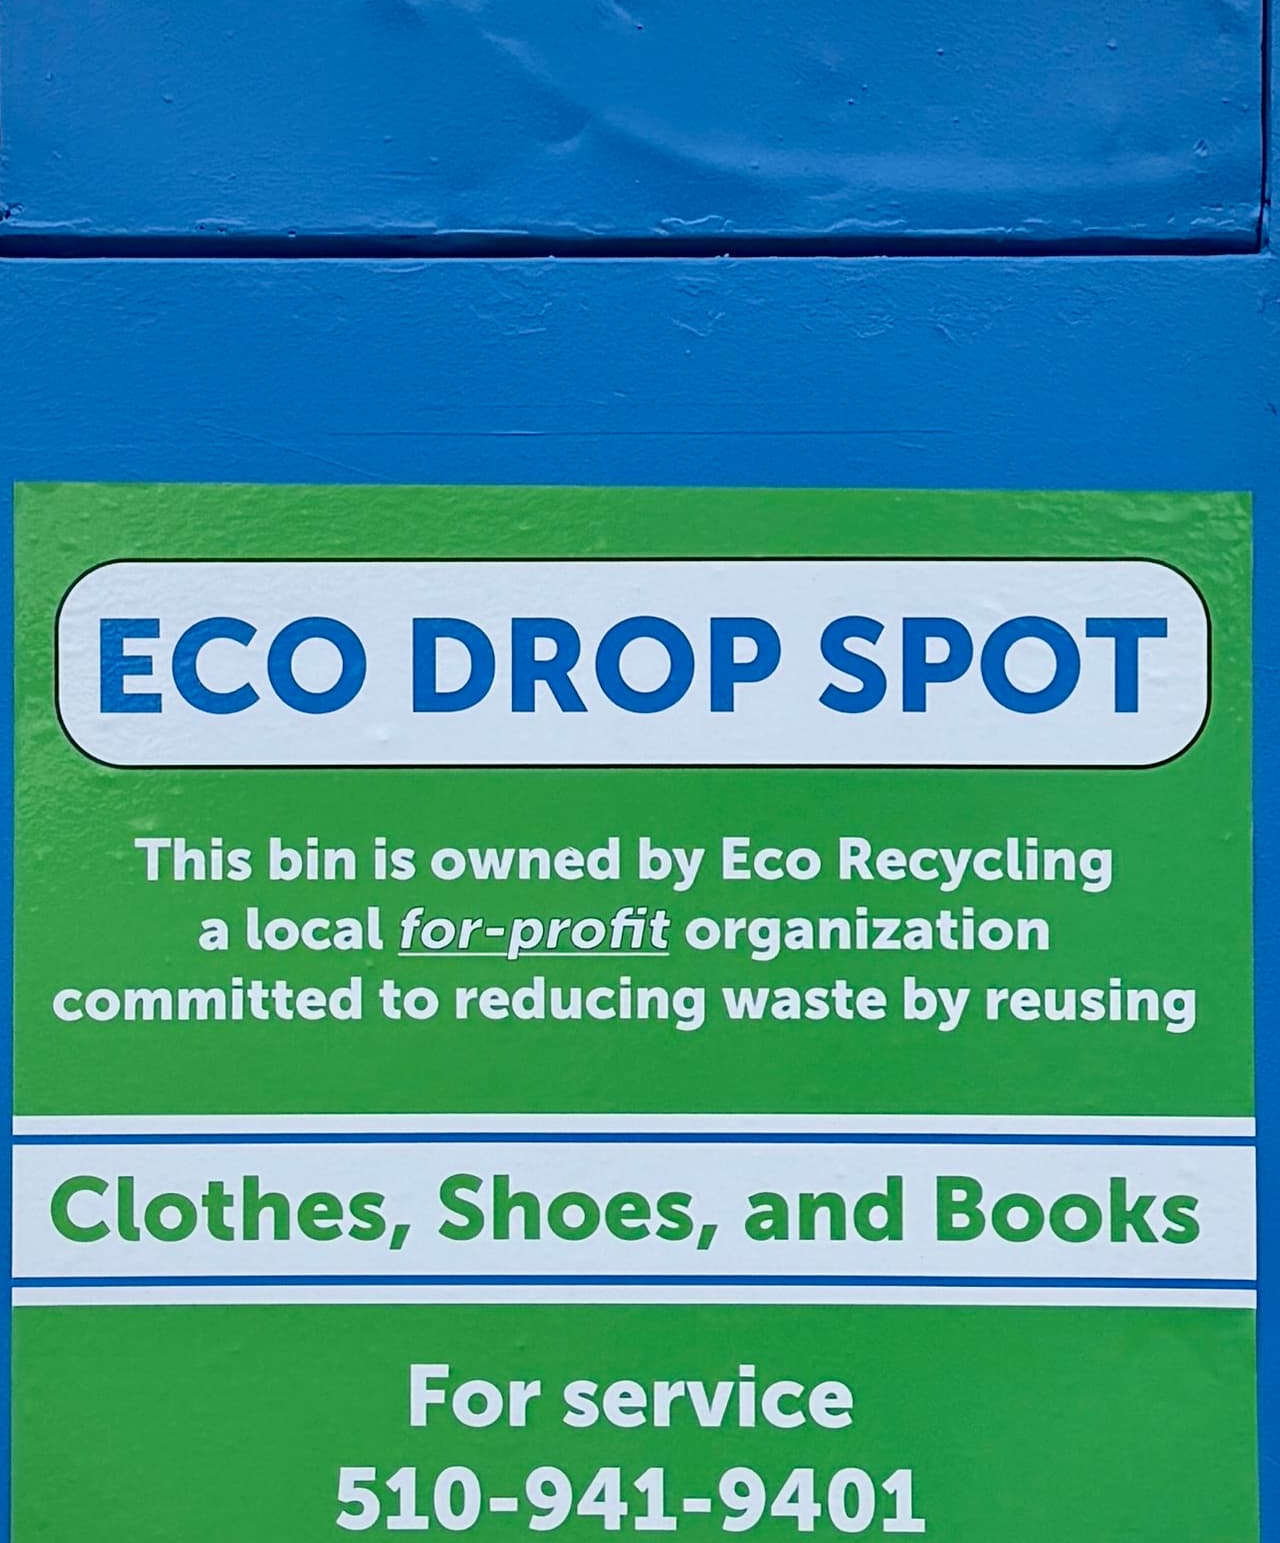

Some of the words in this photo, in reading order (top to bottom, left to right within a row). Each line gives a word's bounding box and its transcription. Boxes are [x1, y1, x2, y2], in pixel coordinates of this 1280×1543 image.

[98, 615, 368, 716] ECO
[412, 614, 783, 715] DROP
[817, 614, 1170, 716] SPOT
[133, 837, 253, 882] This
[268, 836, 357, 882] bin
[373, 836, 416, 882] is
[429, 836, 622, 882] owned
[637, 836, 707, 893] by
[722, 836, 823, 882] Eco
[838, 836, 1114, 893] Recycling
[197, 917, 230, 952] a
[245, 906, 385, 952] local
[396, 906, 671, 960] for-profit
[684, 906, 1051, 963] organization
[51, 975, 363, 1023] committed
[377, 978, 440, 1021] to
[454, 975, 706, 1032] reducing
[720, 978, 888, 1022] waste
[902, 976, 972, 1033] by
[985, 977, 1197, 1034] reusing
[49, 1174, 412, 1252] Clothes,
[437, 1172, 719, 1252] Shoes,
[743, 1174, 906, 1244] and
[935, 1174, 1202, 1246] Books
[409, 1362, 542, 1429] For
[561, 1363, 855, 1430] service
[334, 1464, 927, 1534] 510-941-9401
